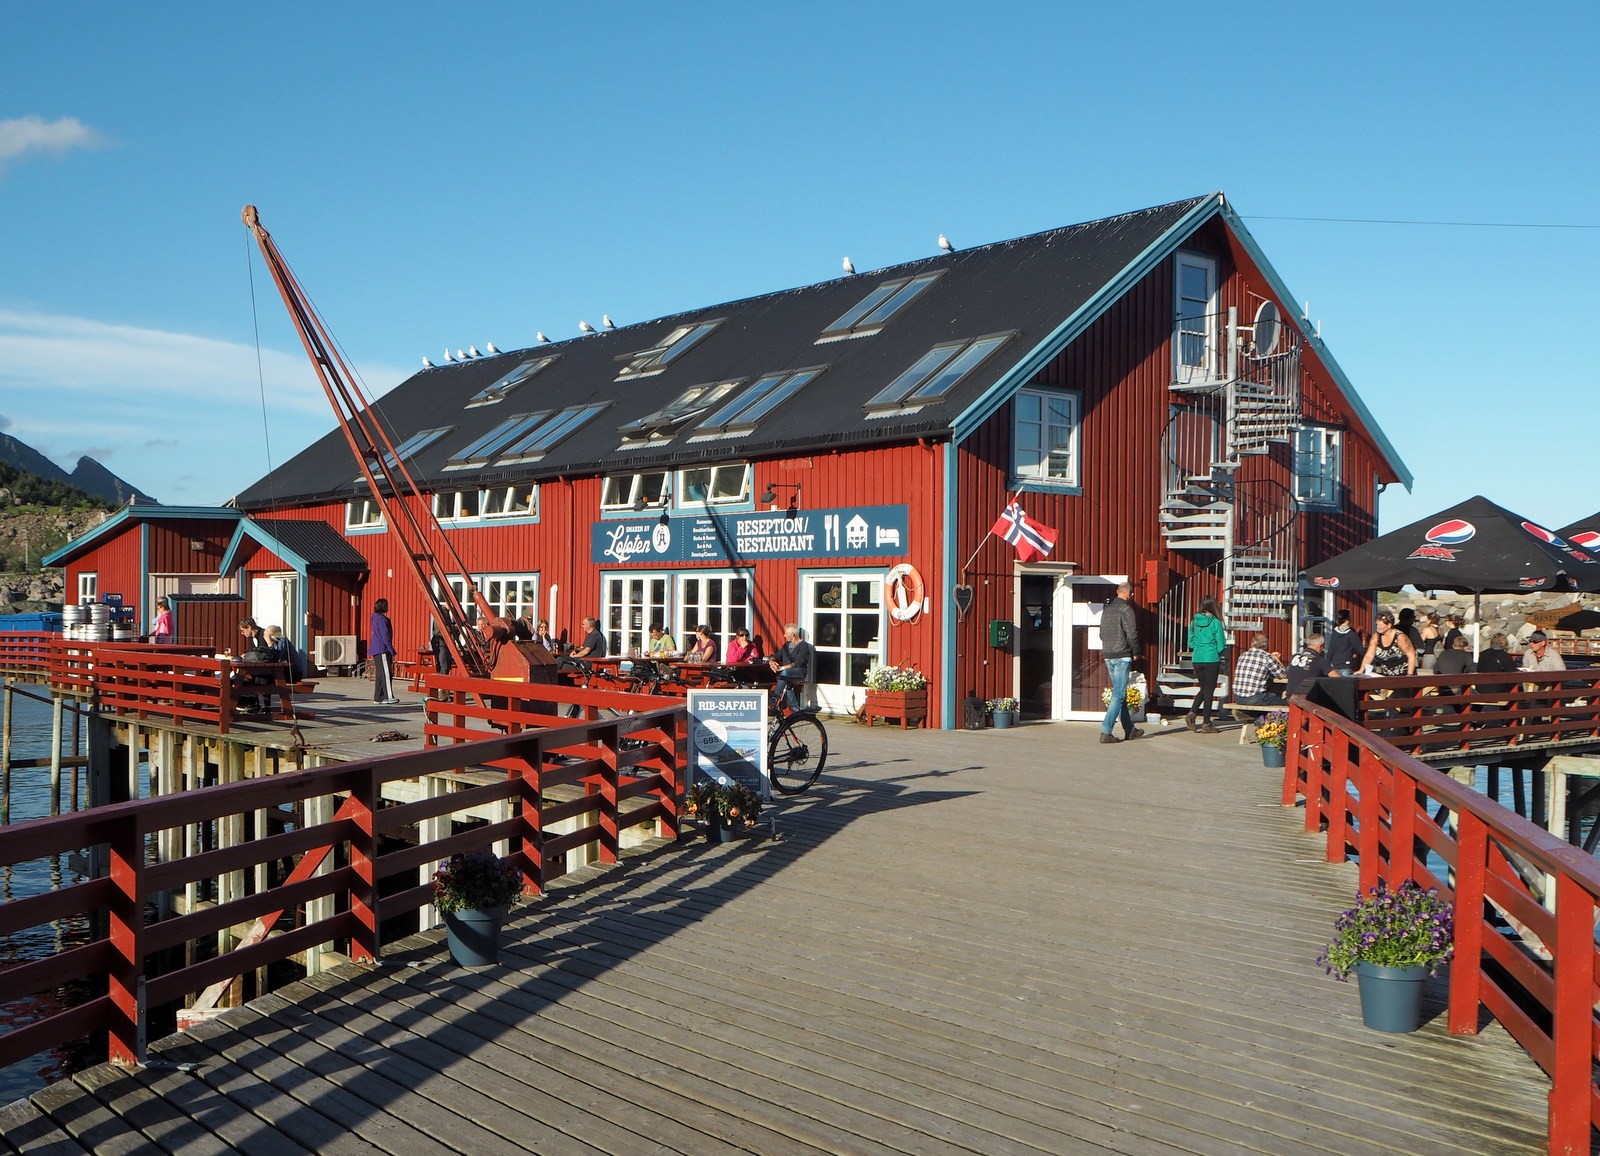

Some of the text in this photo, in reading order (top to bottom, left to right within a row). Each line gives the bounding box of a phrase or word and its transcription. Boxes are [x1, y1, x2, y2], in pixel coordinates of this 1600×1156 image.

[736, 517, 809, 536] RESEPTION/
[604, 525, 651, 563] Lofoten
[736, 535, 814, 553] RESTAURANT
[1291, 655, 1308, 667] 63
[698, 701, 757, 711] RIB-SAFARI
